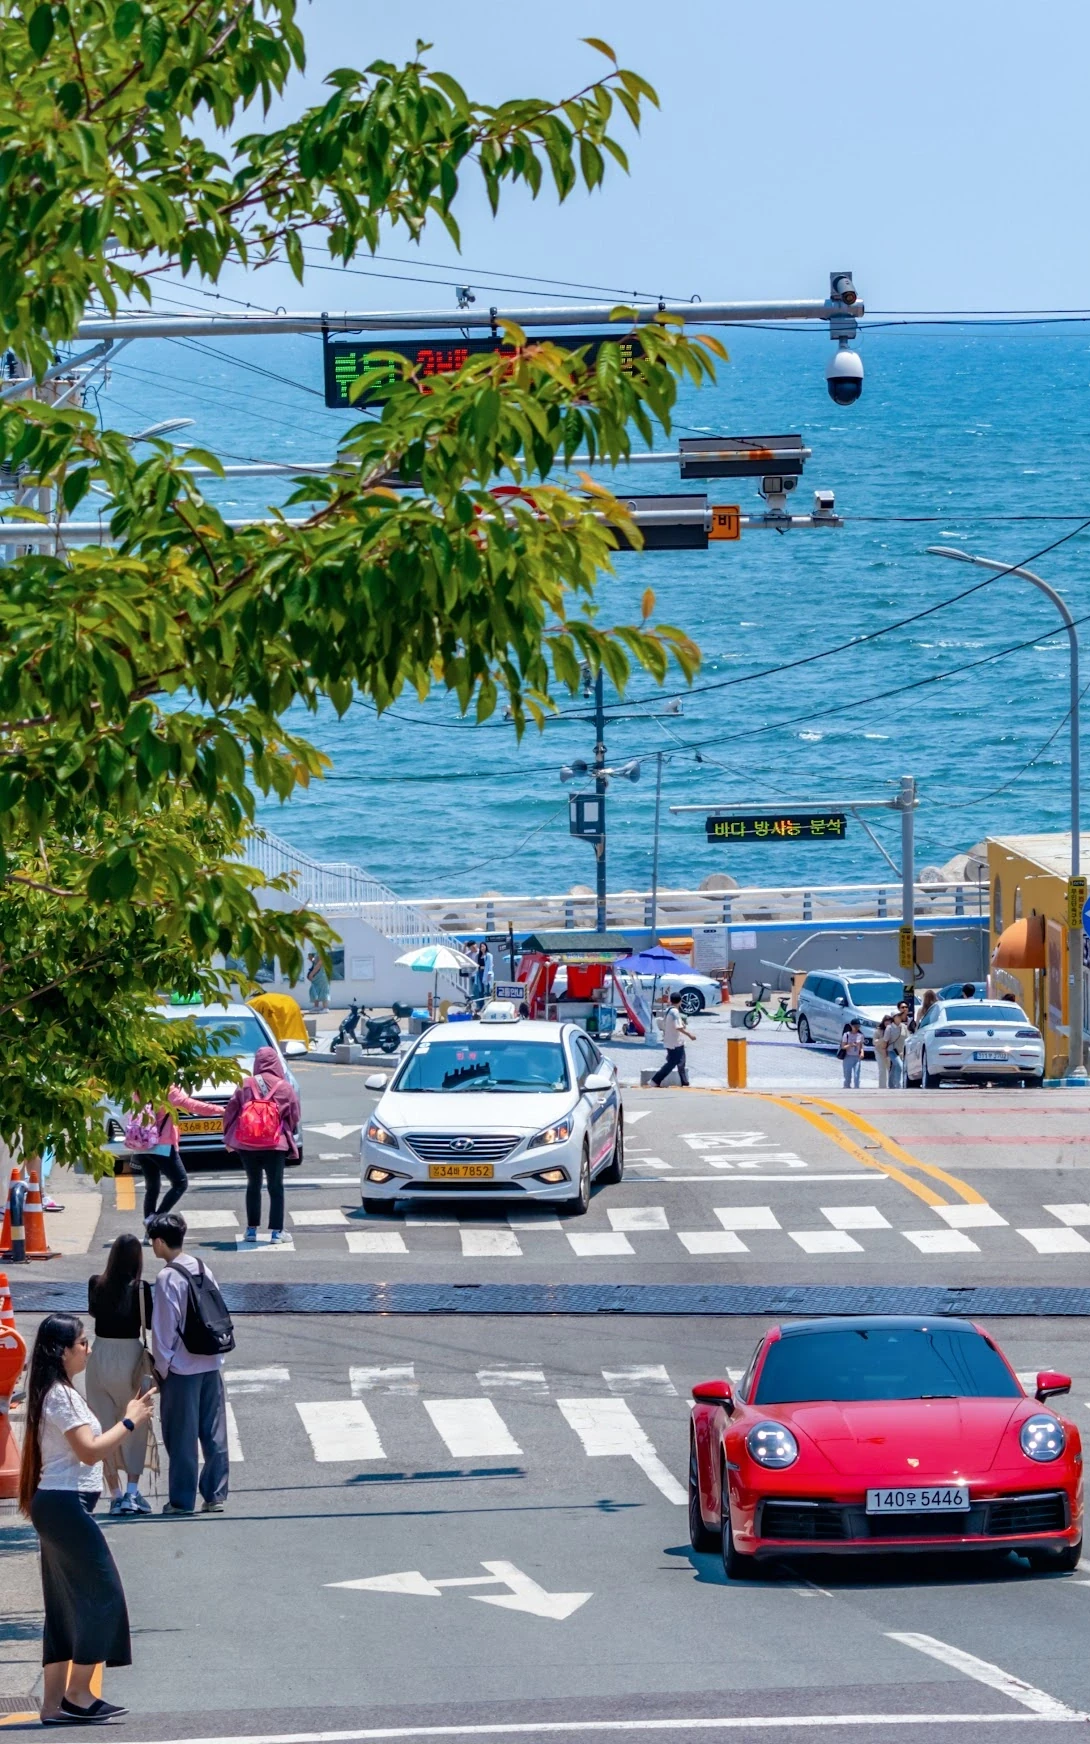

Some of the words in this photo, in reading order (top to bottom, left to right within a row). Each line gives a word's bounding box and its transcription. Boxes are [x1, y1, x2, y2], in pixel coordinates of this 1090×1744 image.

[714, 821, 746, 838] 바다
[754, 820, 801, 837] 방사능
[810, 819, 841, 835] 분석
[203, 1121, 222, 1131] 822
[462, 1166, 489, 1176] 7852
[874, 1492, 917, 1508] 140우
[921, 1490, 963, 1506] 5446
